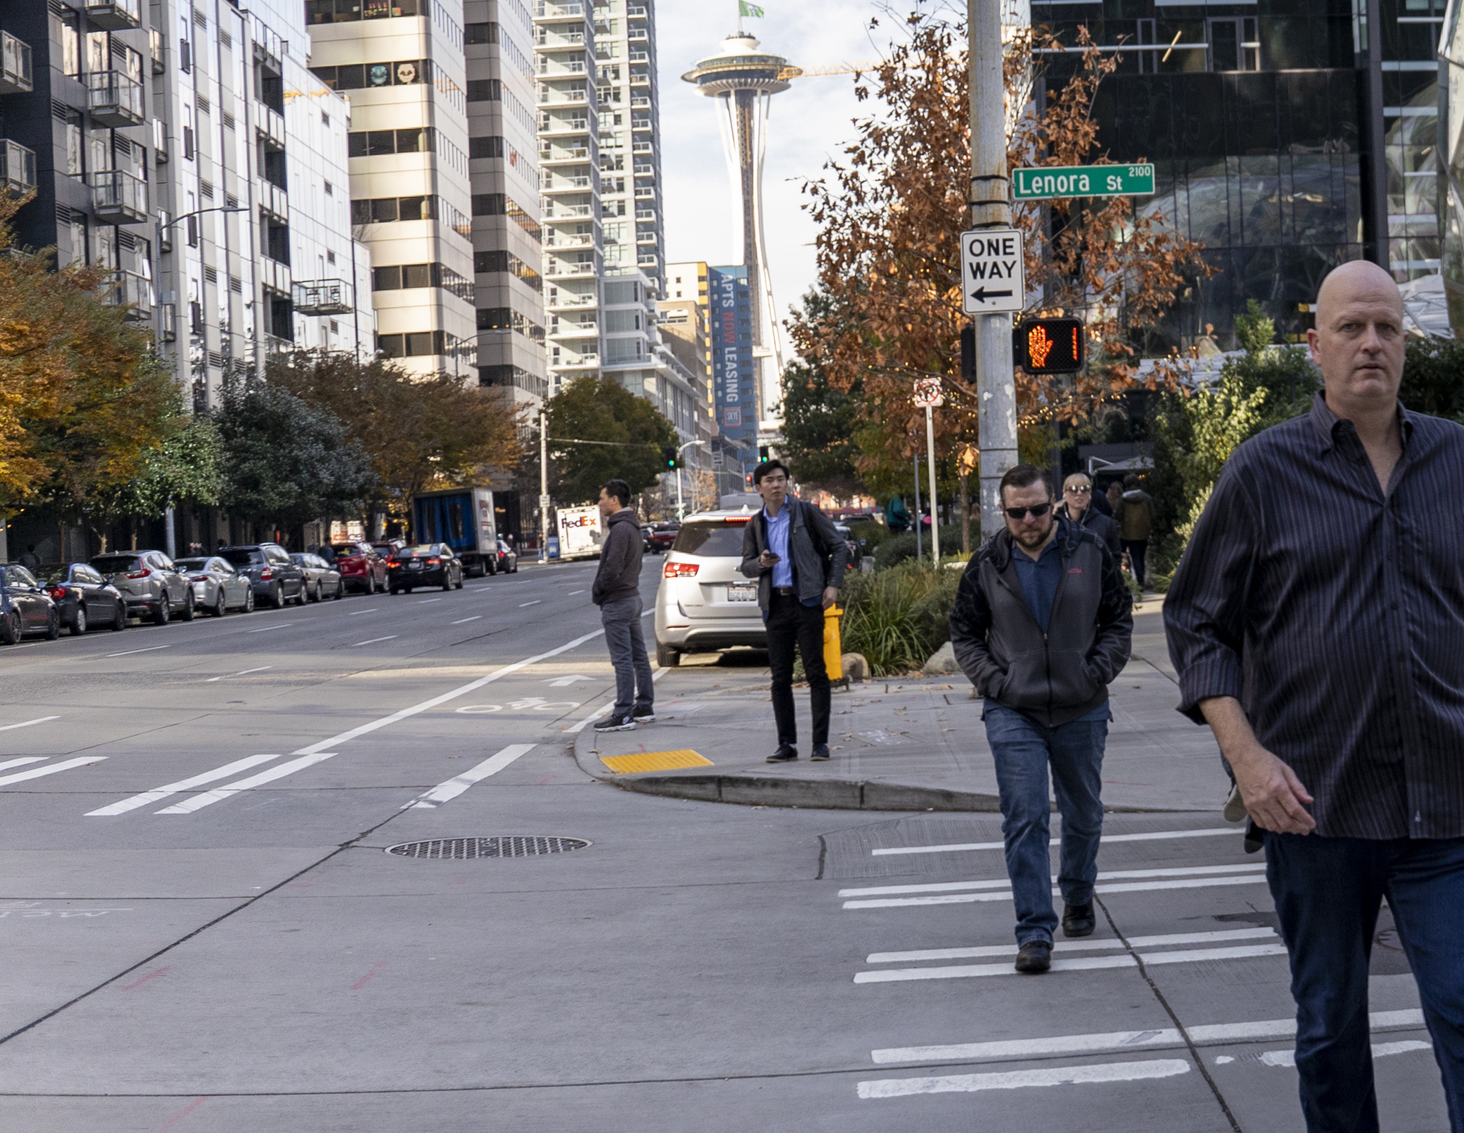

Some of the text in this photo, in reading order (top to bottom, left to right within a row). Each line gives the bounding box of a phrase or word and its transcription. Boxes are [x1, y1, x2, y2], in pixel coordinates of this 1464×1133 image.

[1128, 167, 1151, 177] 2100
[1018, 172, 1123, 194] Lenora St
[969, 238, 1015, 257] ONE
[969, 261, 1017, 280] WAY
[721, 274, 739, 402] APTS NOW LEASING
[561, 515, 596, 529] FedEx
